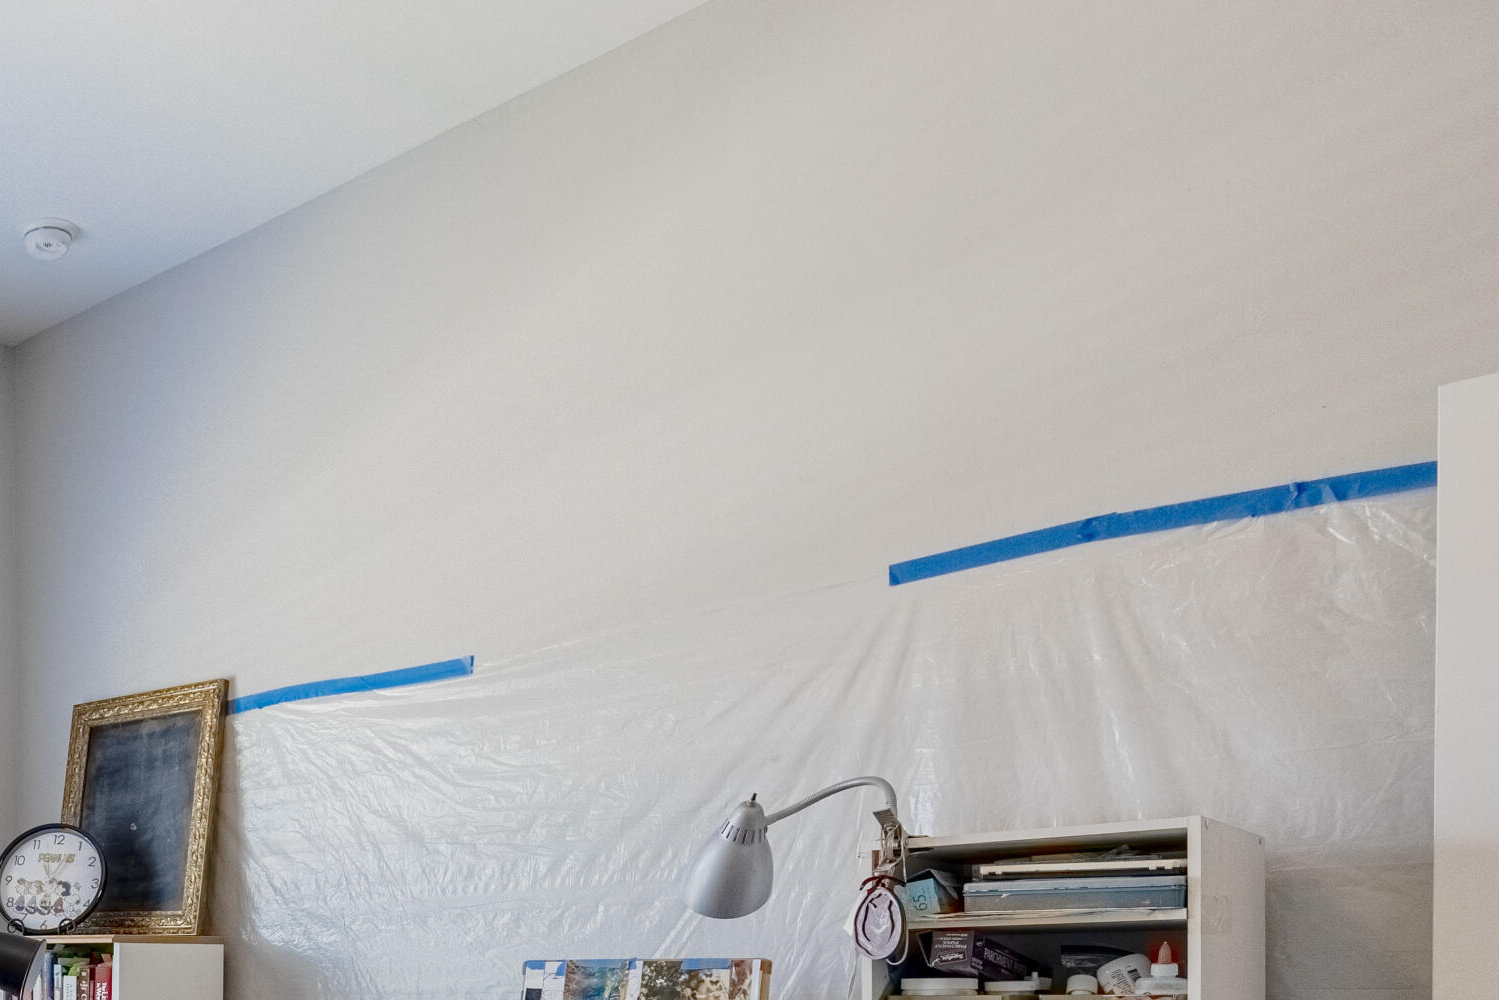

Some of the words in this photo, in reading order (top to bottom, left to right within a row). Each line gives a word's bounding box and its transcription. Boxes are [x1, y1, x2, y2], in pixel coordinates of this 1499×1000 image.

[33, 839, 41, 850] 11
[53, 834, 65, 845] 12
[78, 841, 83, 851] 1
[14, 855, 26, 866] 10
[87, 856, 97, 867] 2
[5, 875, 13, 886] 9
[91, 878, 100, 889] 3
[6, 896, 15, 908] 8
[912, 894, 928, 911] 65
[20, 912, 29, 921] 7
[39, 920, 48, 930] 6
